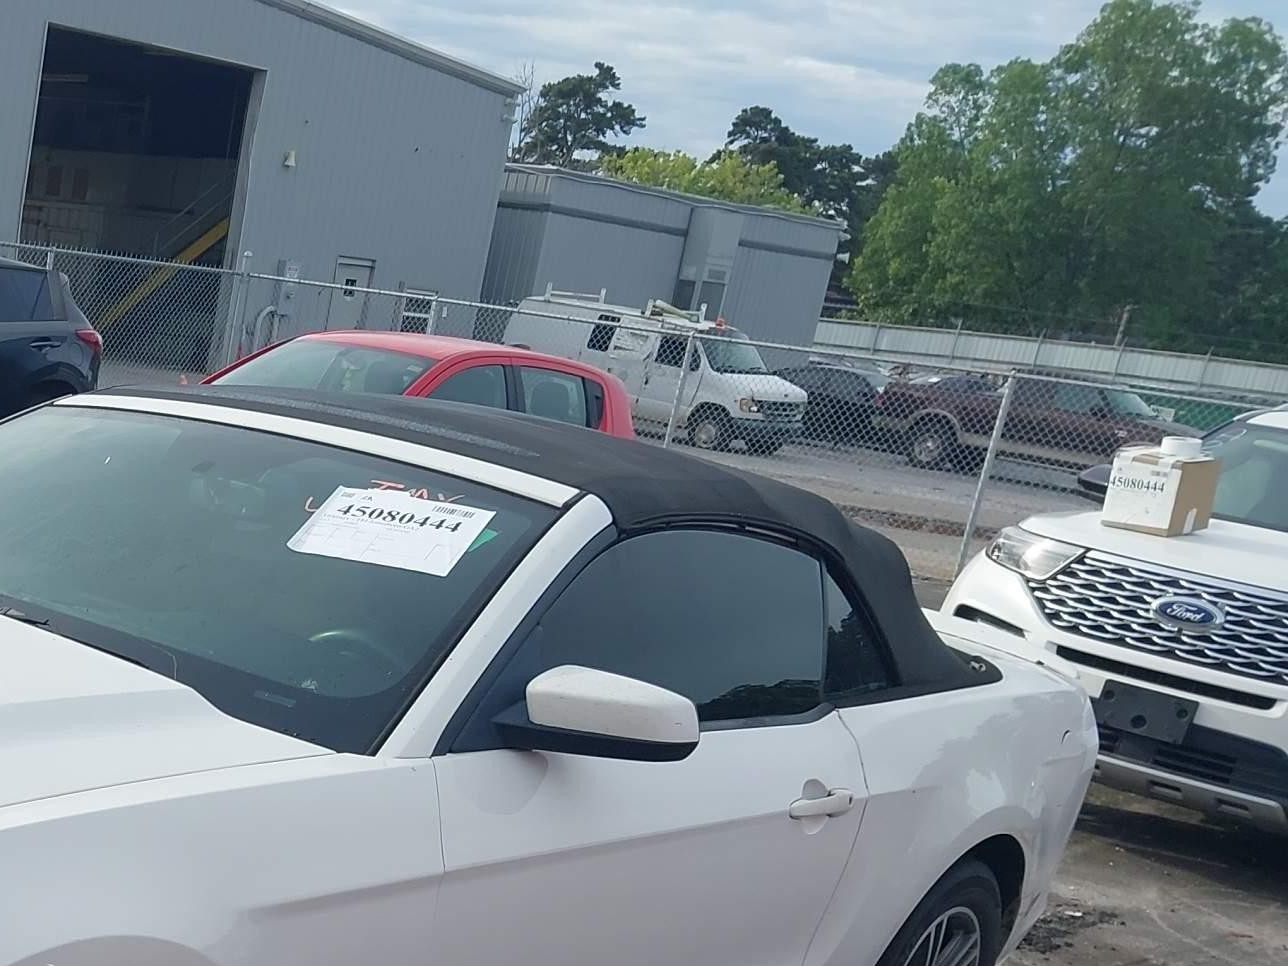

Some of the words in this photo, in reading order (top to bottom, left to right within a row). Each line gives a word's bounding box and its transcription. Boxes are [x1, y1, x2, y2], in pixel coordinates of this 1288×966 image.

[1110, 476, 1165, 493] 45080444
[337, 504, 463, 533] 45080444
[1166, 603, 1206, 621] Ford
